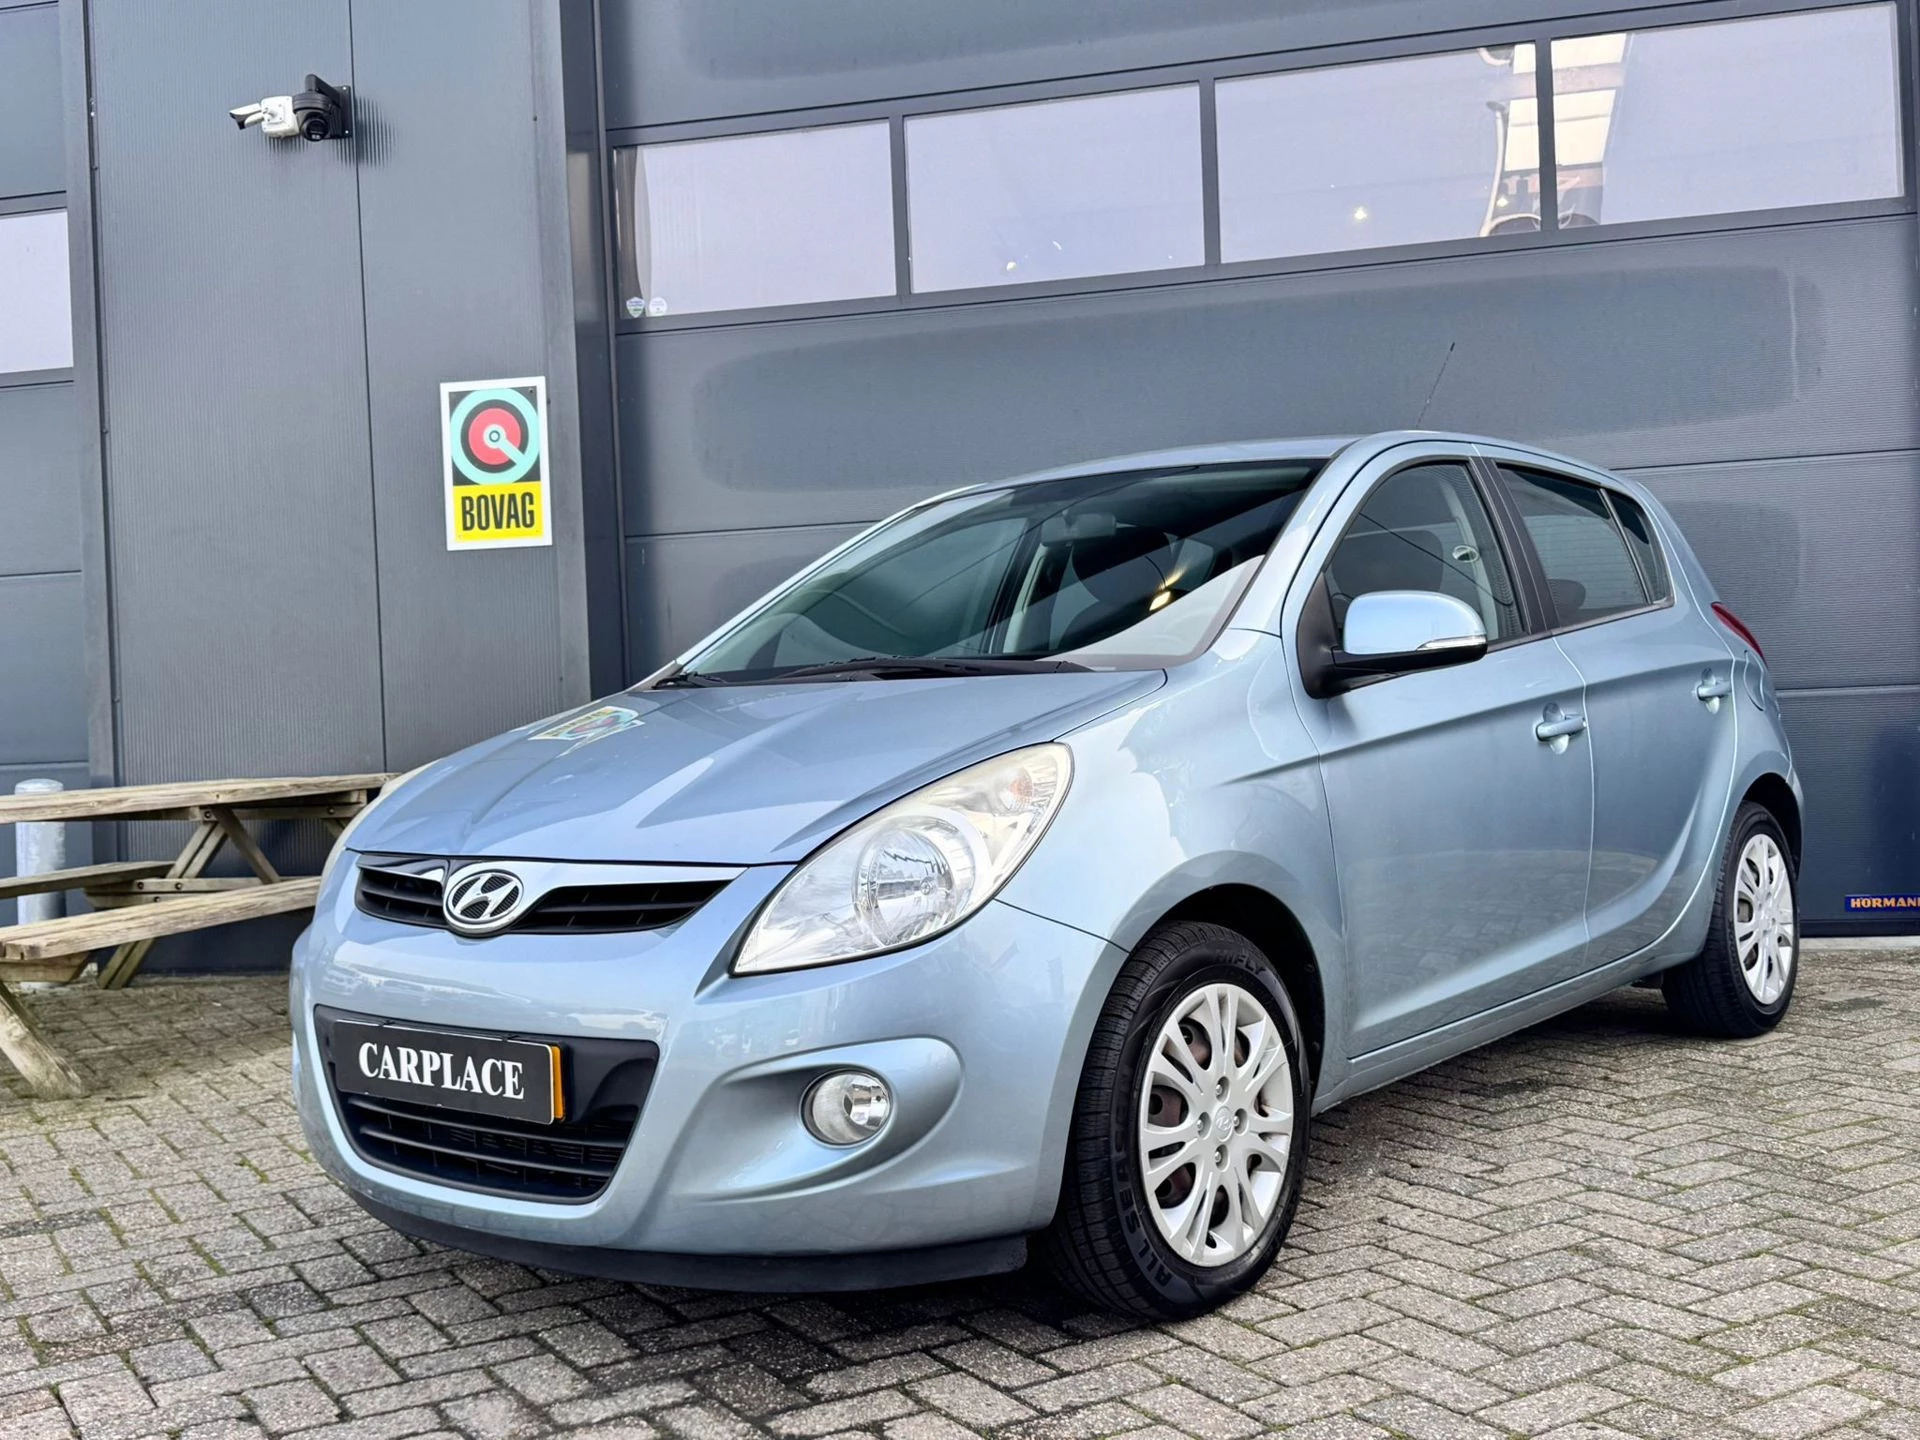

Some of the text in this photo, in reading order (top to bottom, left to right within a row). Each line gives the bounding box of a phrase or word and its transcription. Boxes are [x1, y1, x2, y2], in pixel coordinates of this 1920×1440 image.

[461, 491, 535, 531] BOVAG
[358, 1042, 524, 1100] CARPLACE
[1138, 1238, 1174, 1287] ALL
